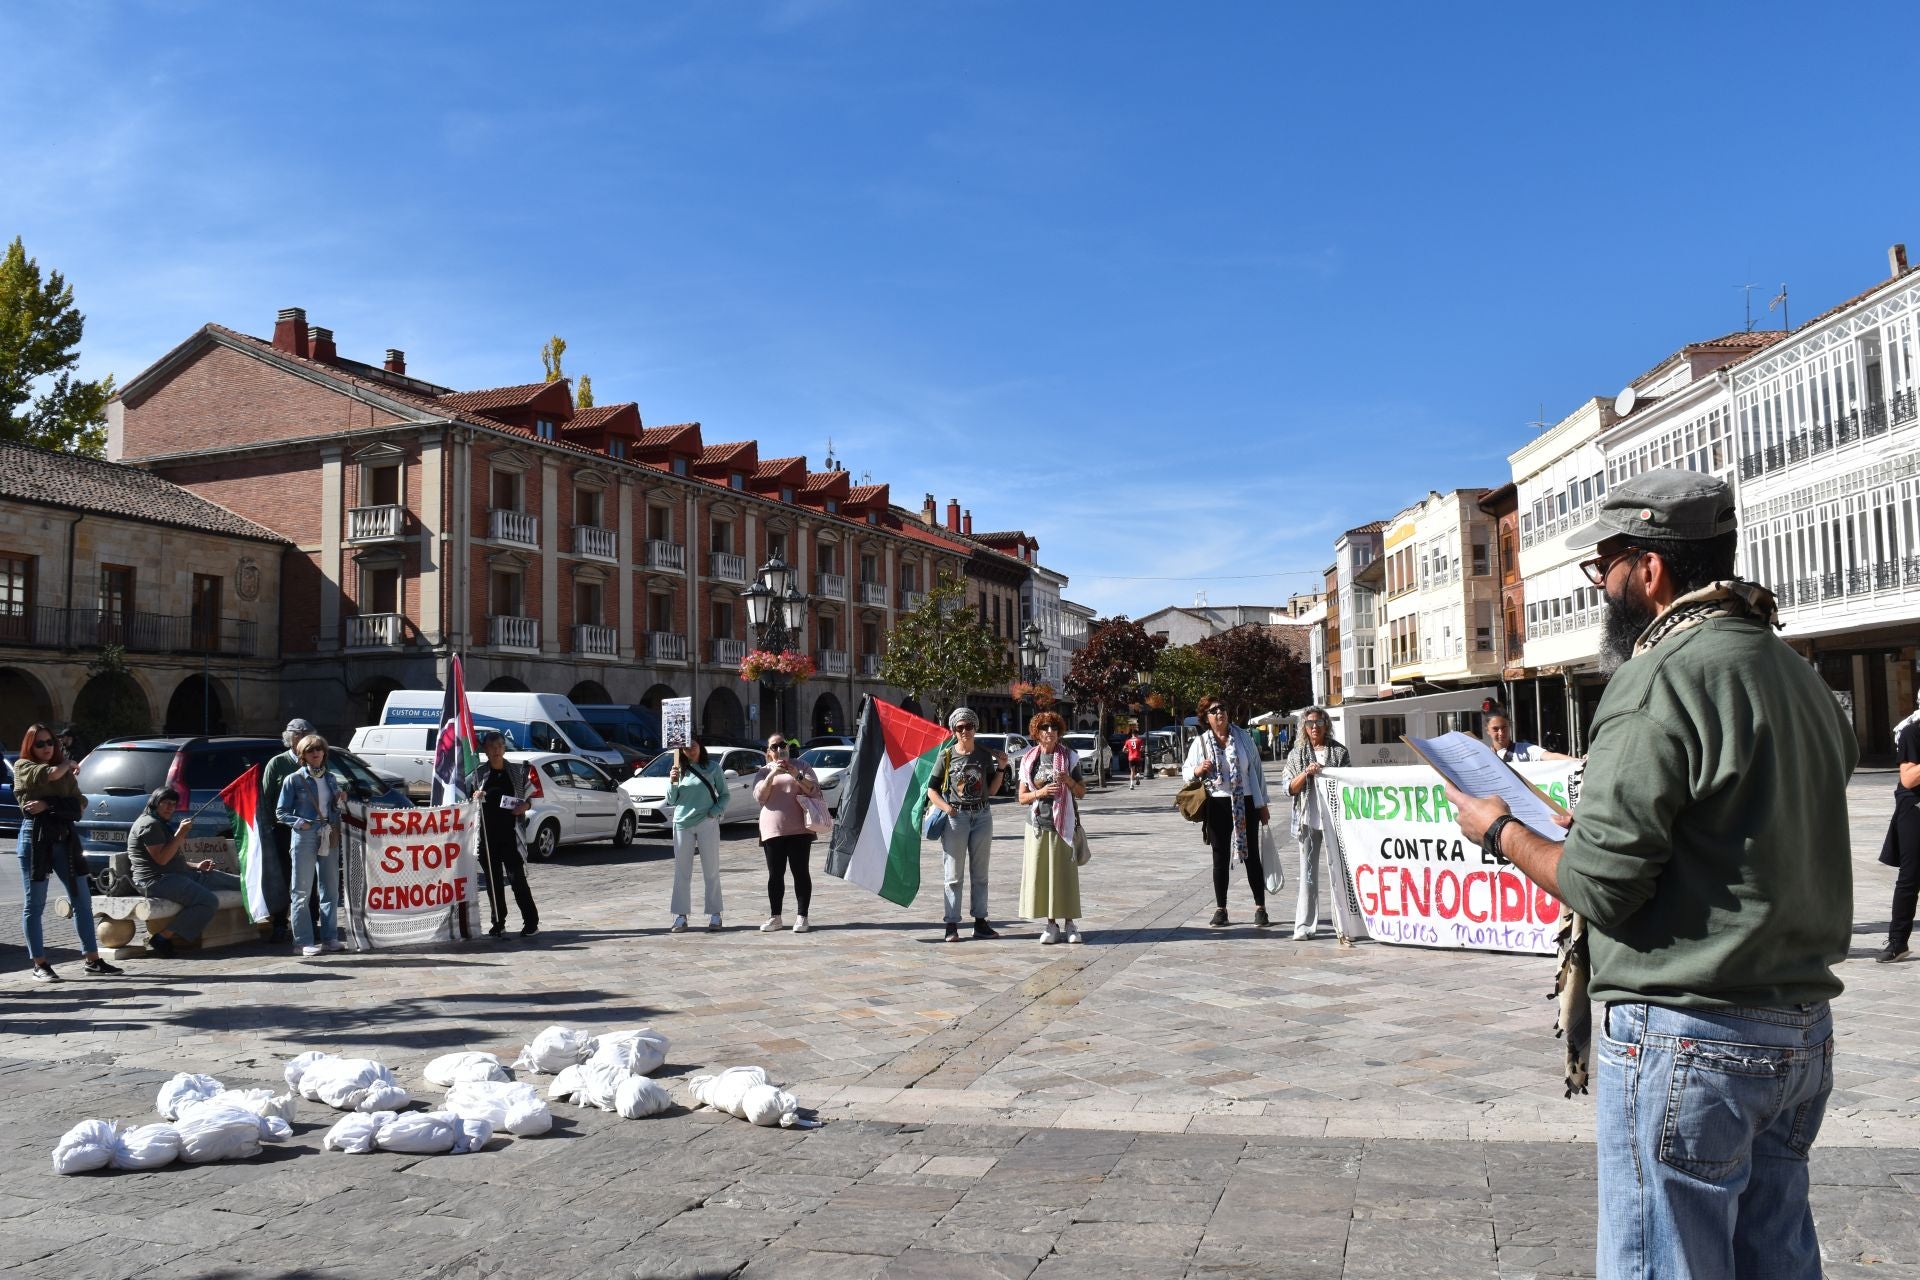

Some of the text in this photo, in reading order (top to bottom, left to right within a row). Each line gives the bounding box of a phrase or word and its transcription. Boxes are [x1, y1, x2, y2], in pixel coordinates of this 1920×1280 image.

[391, 709, 420, 717] CUSTOM
[1131, 740, 1137, 750] 9
[1342, 783, 1459, 824] NUESTRA
[369, 808, 465, 838] ISRAEL
[380, 842, 461, 874] STOP
[1380, 837, 1465, 863] CONTRA
[1355, 863, 1561, 925] GENOCIDIO
